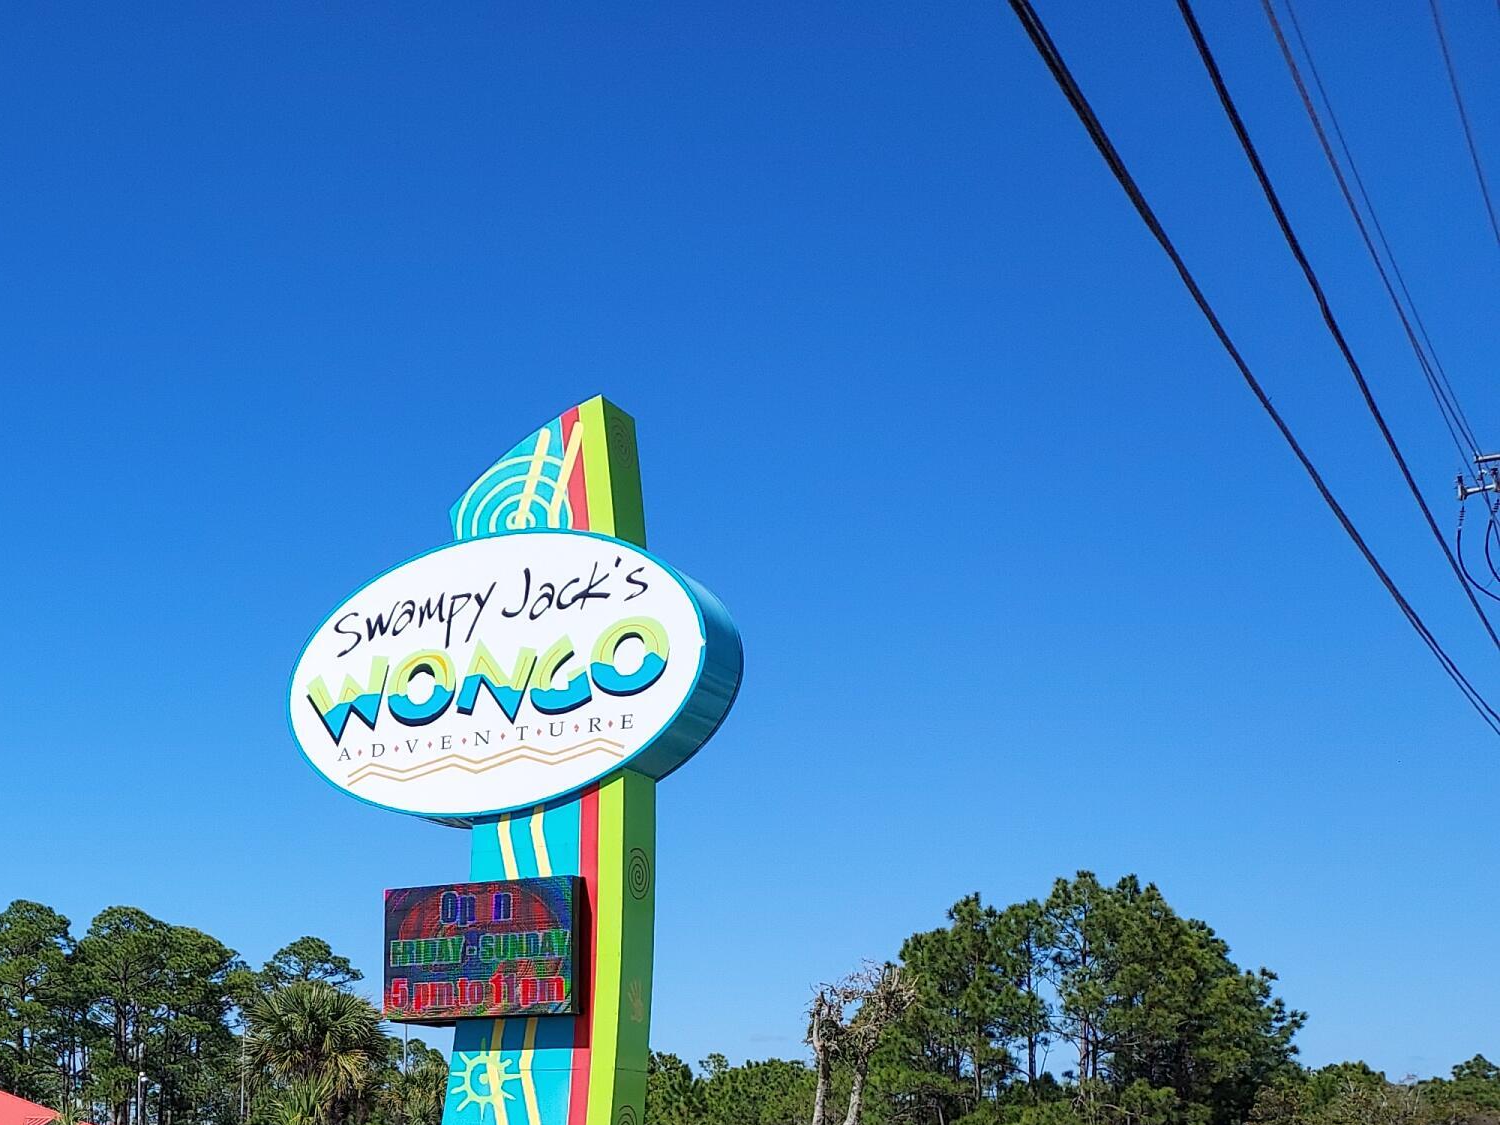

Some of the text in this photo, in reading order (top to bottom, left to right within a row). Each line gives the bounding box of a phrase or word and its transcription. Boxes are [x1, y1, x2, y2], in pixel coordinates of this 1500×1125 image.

[334, 556, 649, 657] Swampy Jack's
[306, 615, 670, 747] WONGO
[390, 935, 464, 967] FRIDAY
[479, 928, 570, 963] SUNDAY
